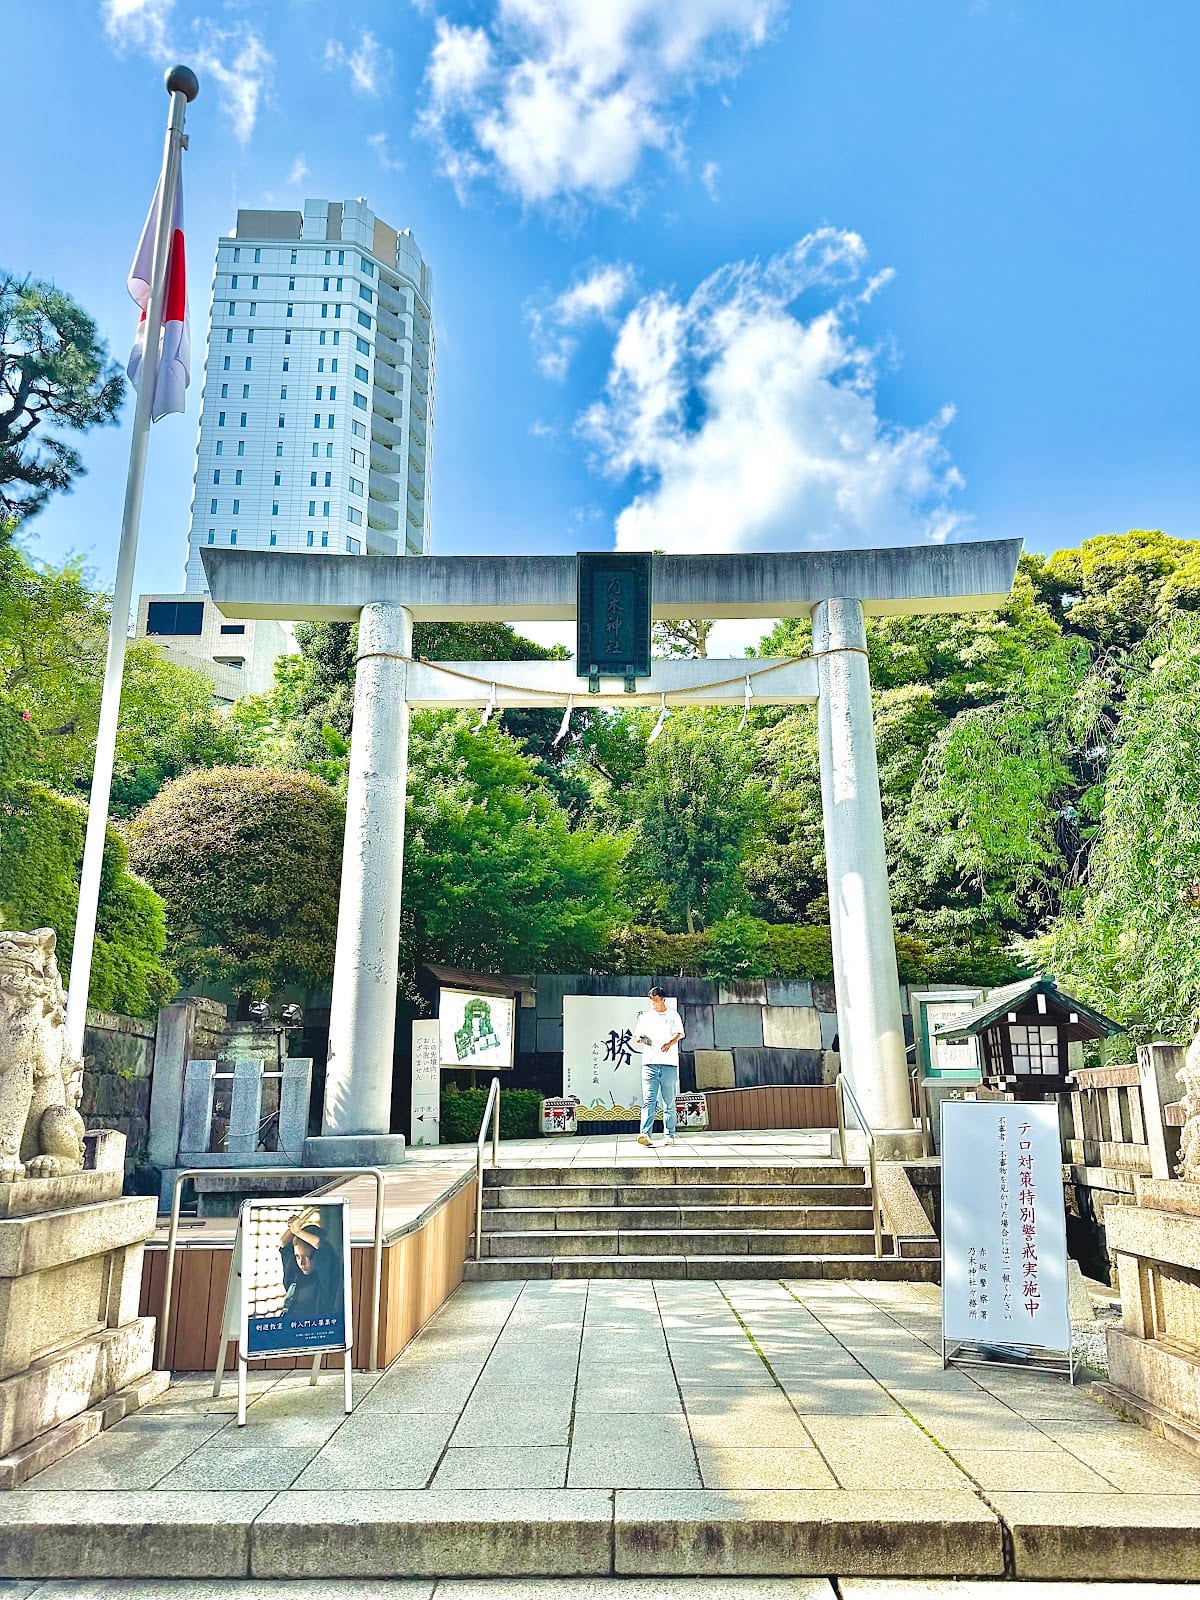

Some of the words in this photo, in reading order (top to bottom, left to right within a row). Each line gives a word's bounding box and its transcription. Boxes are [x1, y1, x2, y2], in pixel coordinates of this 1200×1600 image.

[605, 576, 624, 655] 乃木神社
[415, 1038, 423, 1081] ございません
[422, 1038, 430, 1073] お手洗いは
[600, 1028, 643, 1073] 勝
[1017, 1122, 1041, 1319] テロ対策特別警戒実施中
